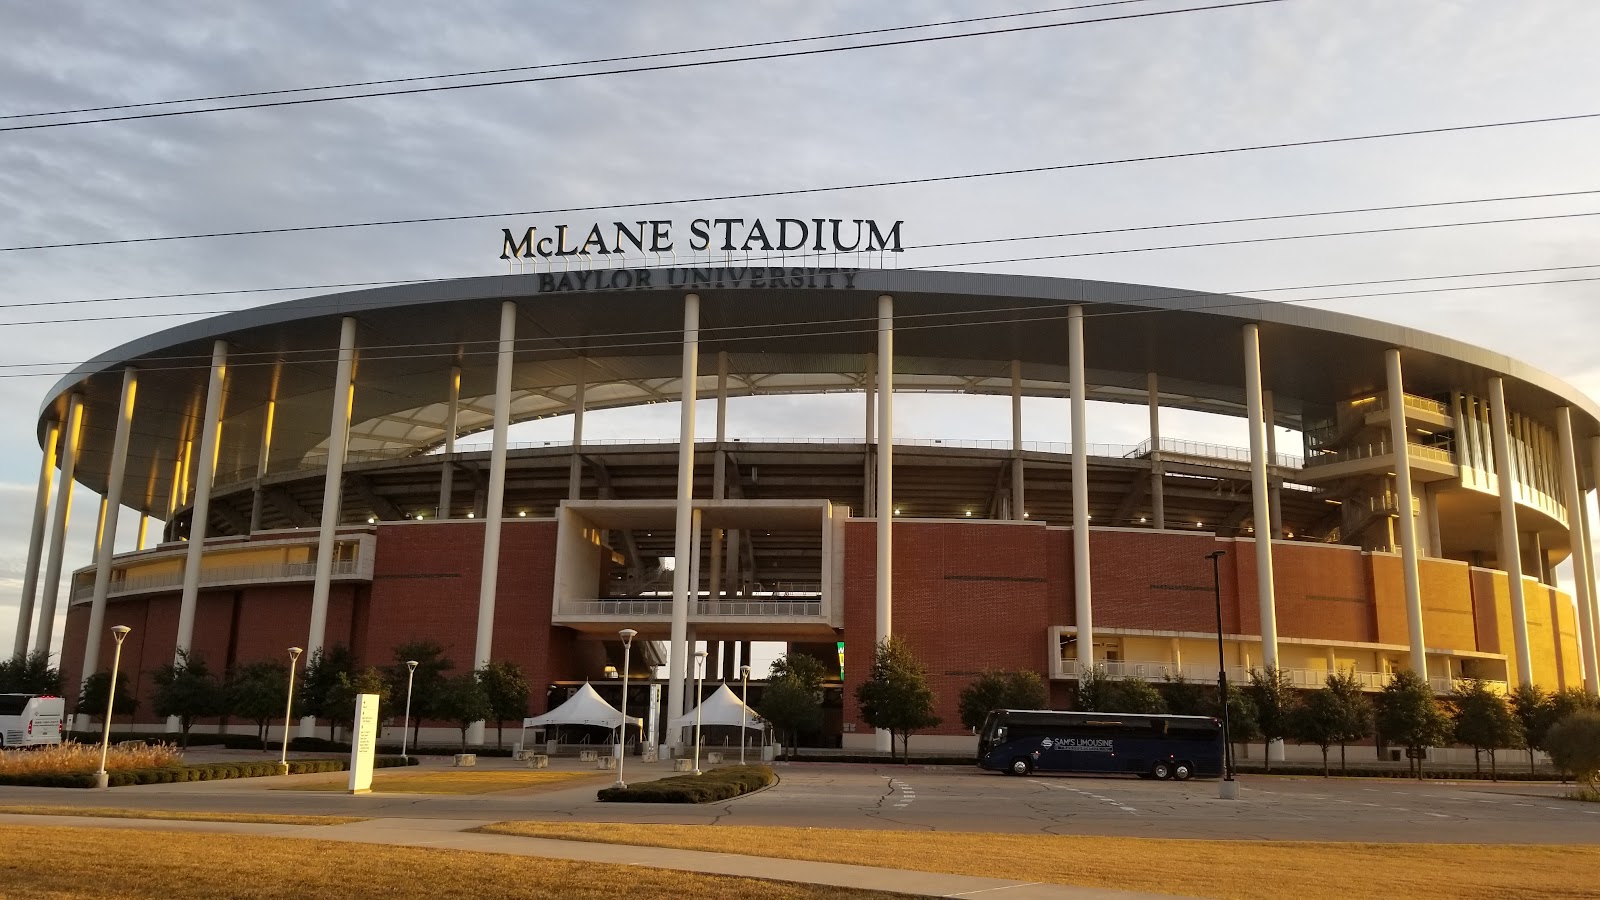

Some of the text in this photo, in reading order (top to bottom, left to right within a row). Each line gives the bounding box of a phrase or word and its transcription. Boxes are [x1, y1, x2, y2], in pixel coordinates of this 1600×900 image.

[500, 217, 905, 259] McLANE STADIUM
[537, 267, 861, 293] BAYLOR UNIVERSITY
[1054, 738, 1113, 747] SAM'S LIMOUSINE
